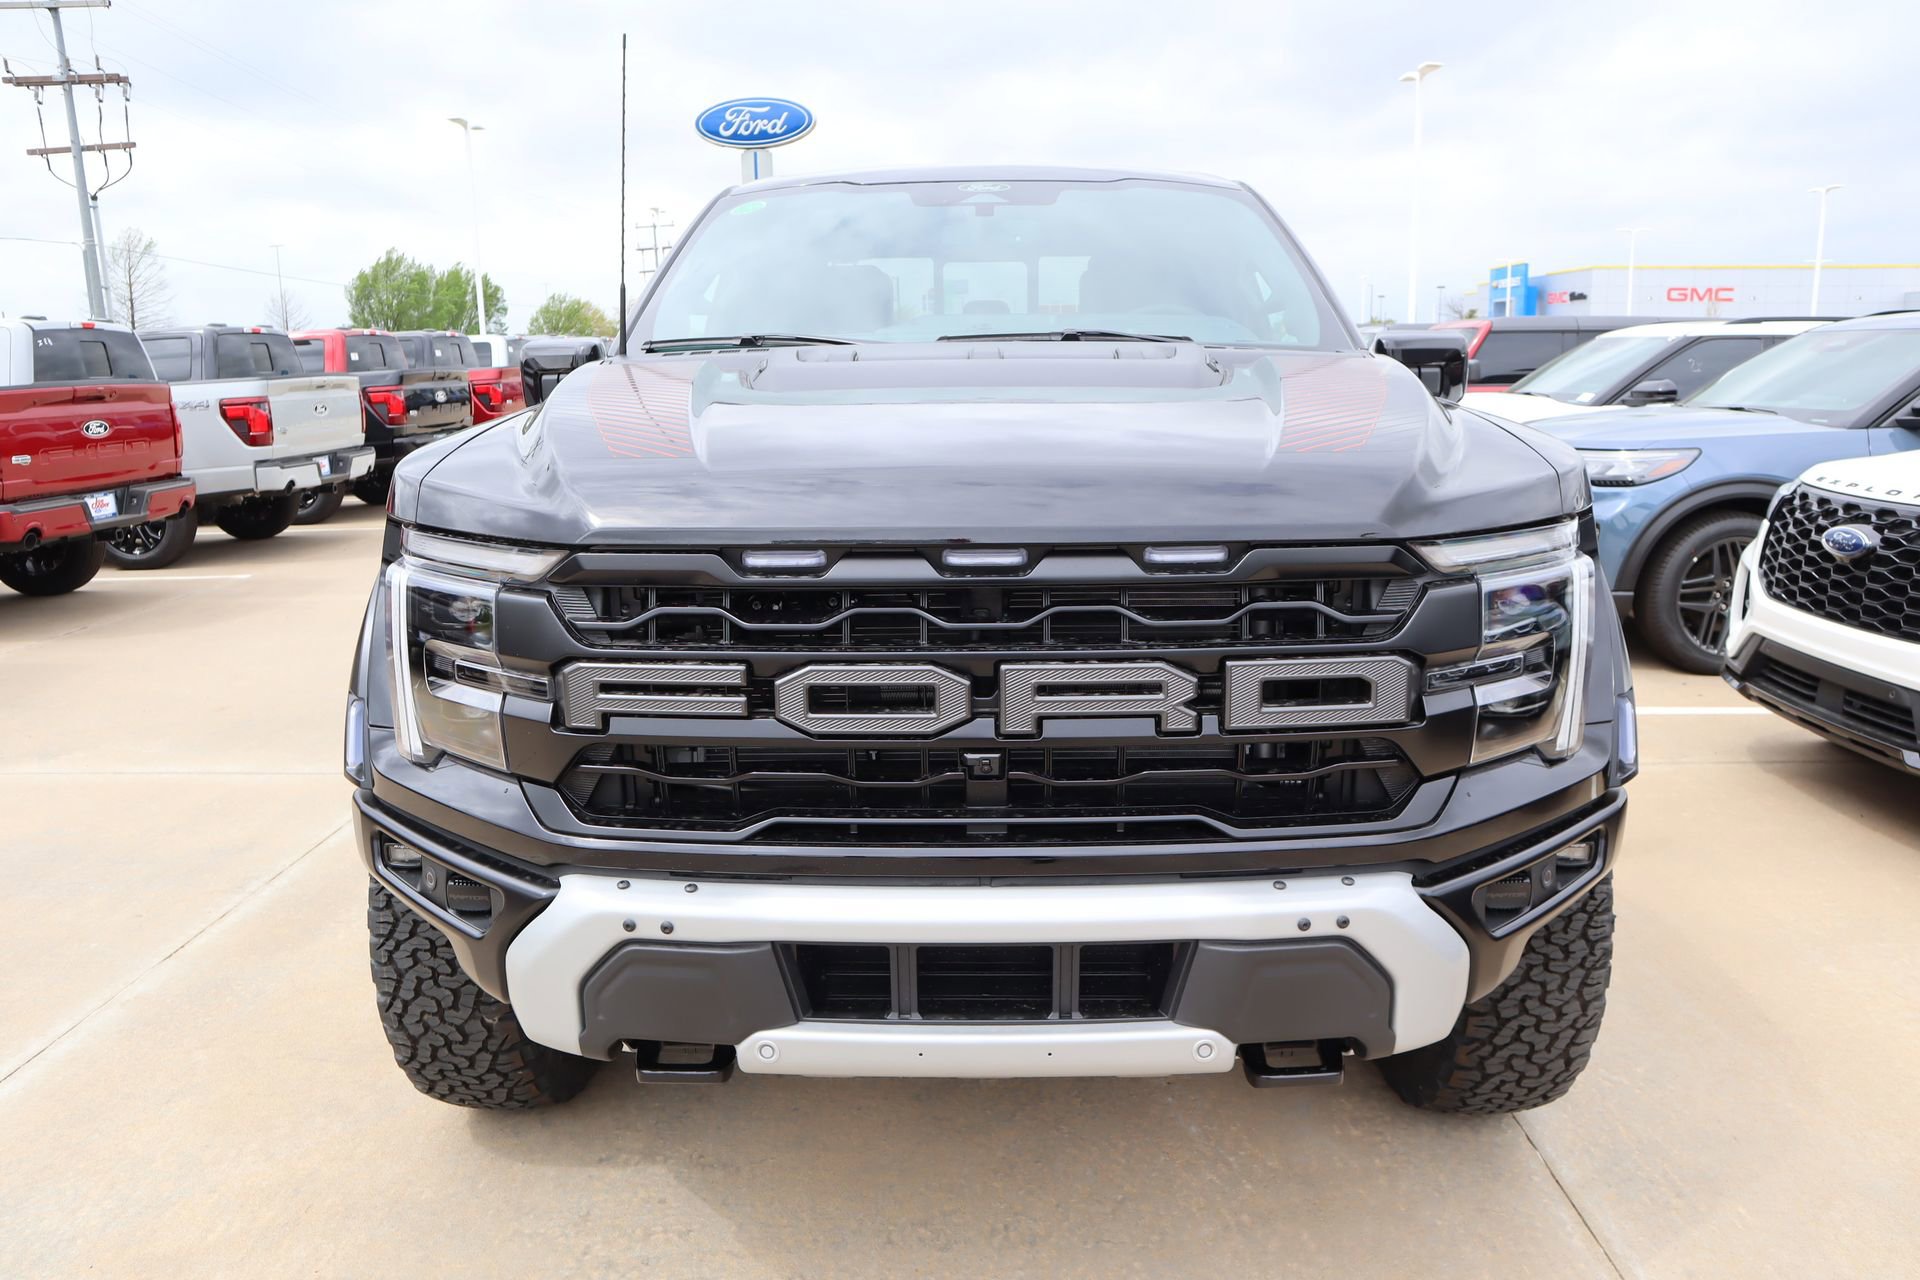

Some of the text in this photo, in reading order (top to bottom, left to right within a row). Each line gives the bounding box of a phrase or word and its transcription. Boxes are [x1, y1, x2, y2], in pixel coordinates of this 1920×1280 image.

[719, 106, 789, 137] Ford
[1666, 287, 1735, 302] GMC
[89, 422, 105, 434] Ford
[562, 656, 1412, 734] FORD
